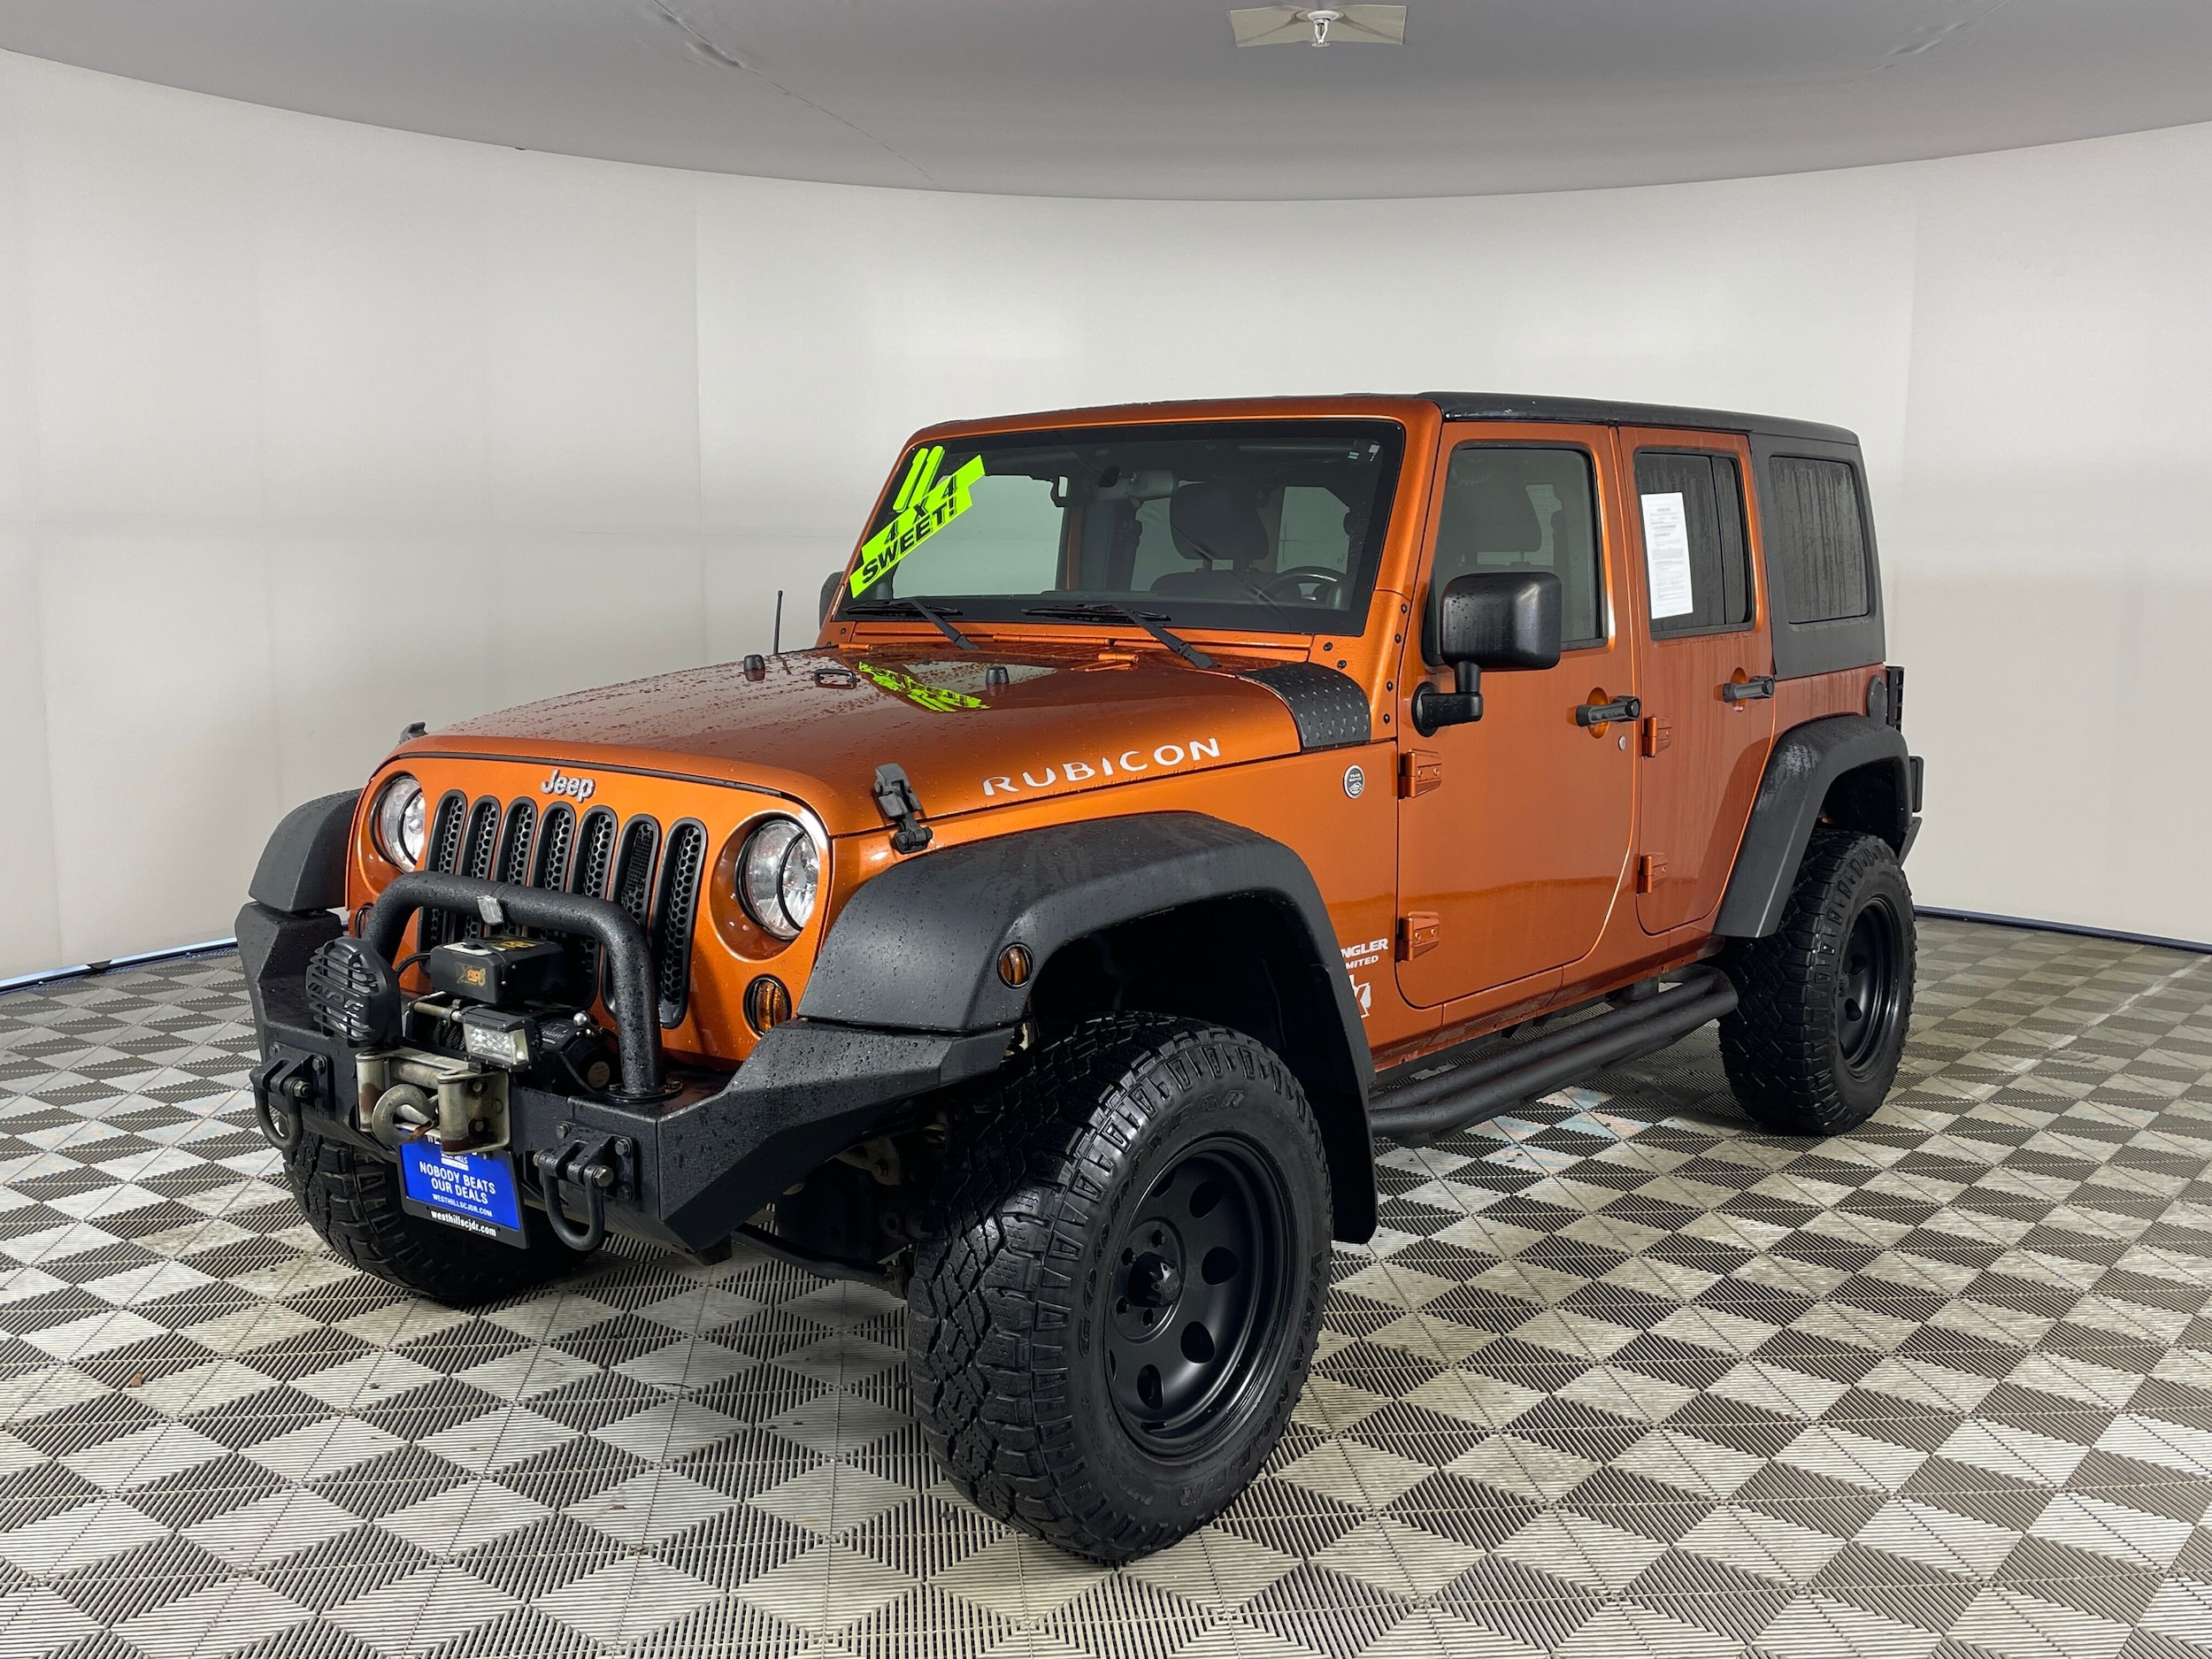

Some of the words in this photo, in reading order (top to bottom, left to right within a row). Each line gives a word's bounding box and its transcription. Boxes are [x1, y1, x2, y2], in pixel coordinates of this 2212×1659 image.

[862, 496, 957, 585] SWEET!
[982, 738, 1220, 796] RUBICON
[541, 768, 595, 803] Jeep
[1340, 938, 1389, 958] NGLER
[1345, 956, 1379, 970] MITED
[419, 1161, 460, 1183] NOBODY
[463, 1174, 496, 1194] BEATS
[431, 1178, 453, 1194] OUR
[455, 1184, 488, 1204] DEALS
[431, 1210, 497, 1237] westhillscjdr.com
